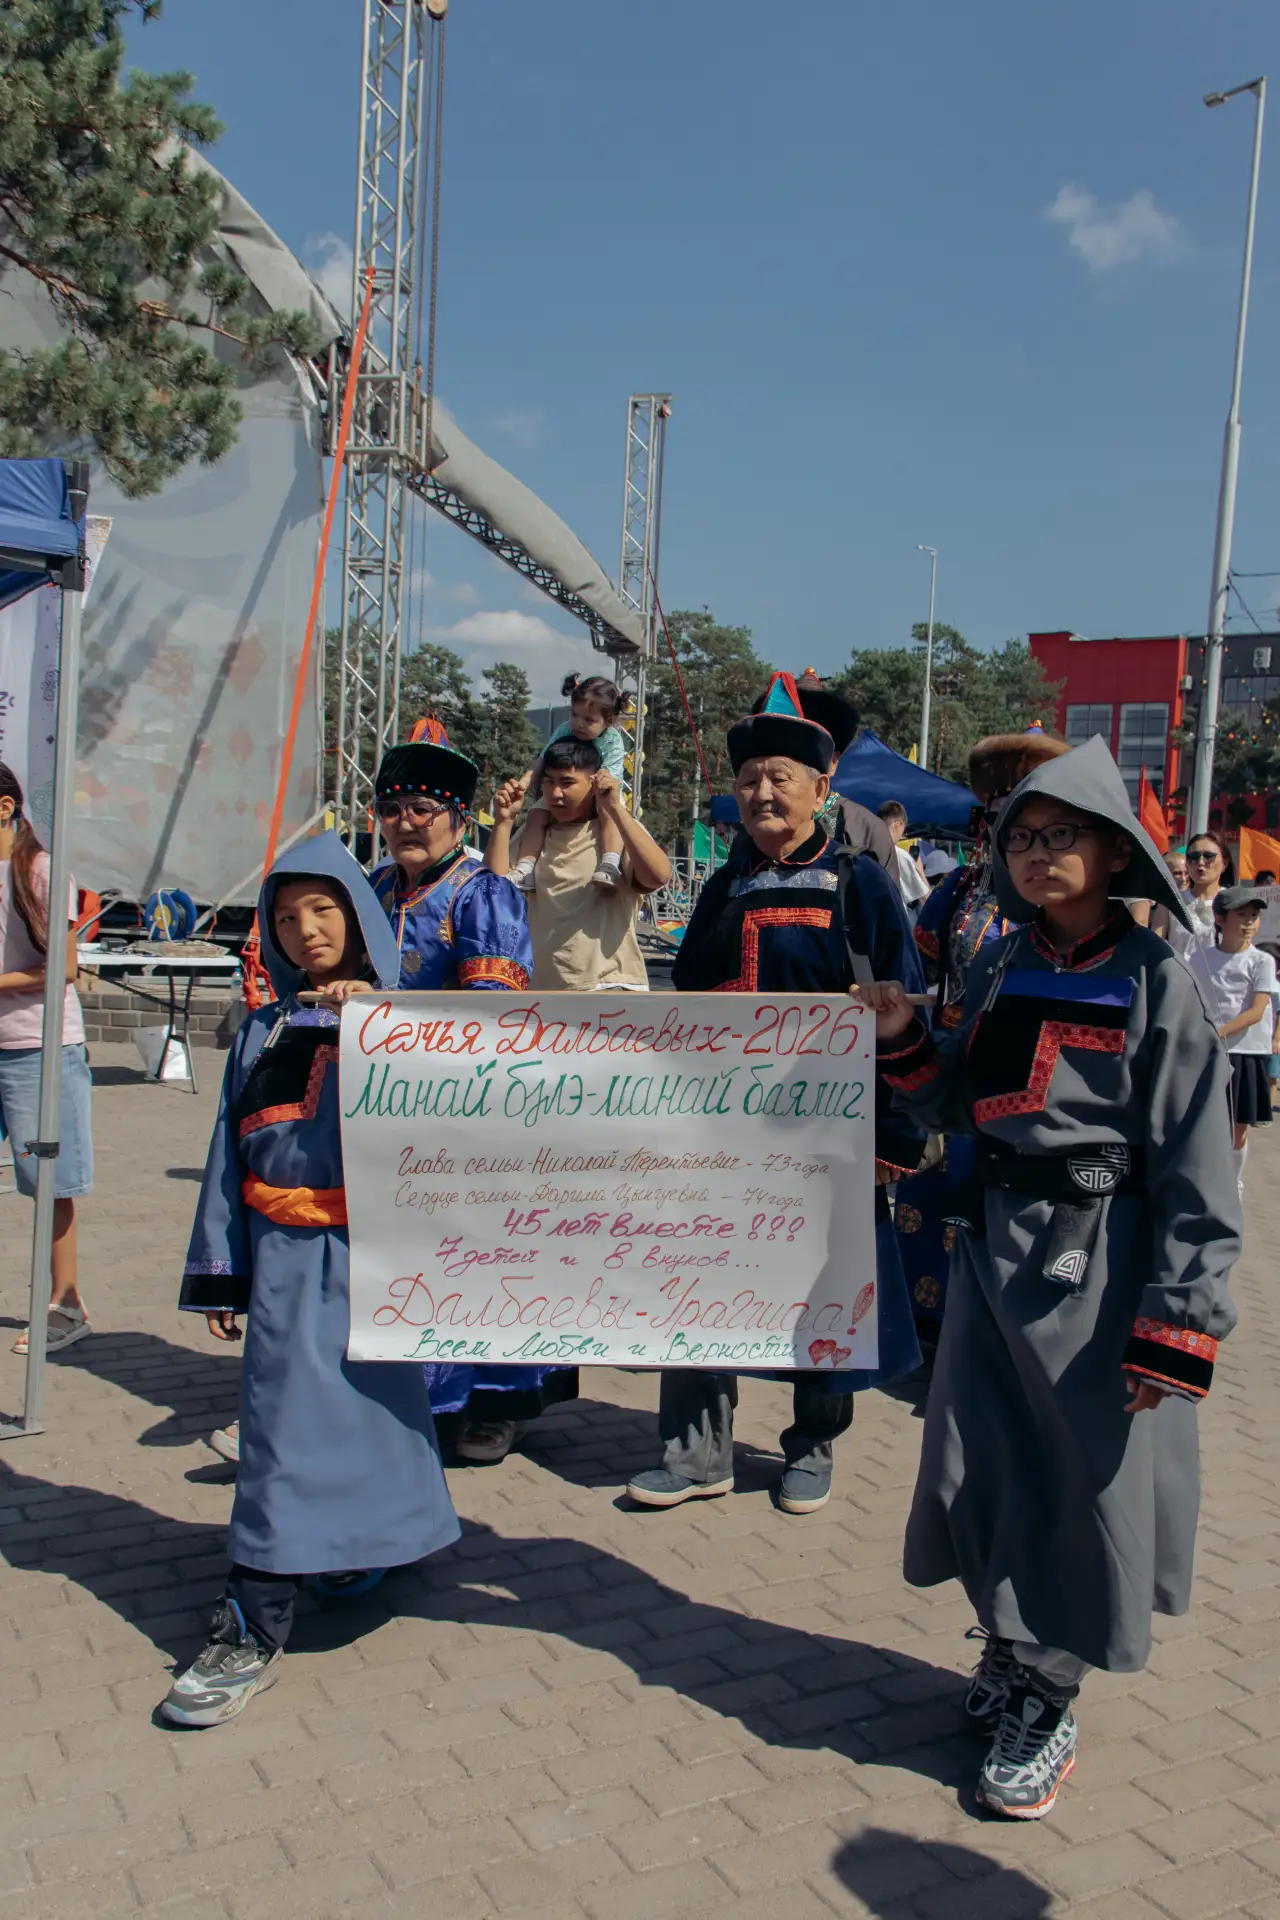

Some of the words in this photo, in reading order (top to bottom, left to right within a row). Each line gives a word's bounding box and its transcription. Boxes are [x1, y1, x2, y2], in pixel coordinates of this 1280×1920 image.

[358, 1000, 486, 1056] Семья
[344, 1059, 498, 1119] Манай
[397, 1145, 456, 1177] Глава
[394, 1180, 460, 1216] Сердце
[609, 1212, 738, 1239] вместе
[559, 1256, 579, 1266] и
[603, 1242, 633, 1270] 8
[403, 1328, 494, 1359] Всем
[502, 1331, 611, 1359] Любви
[627, 1343, 647, 1357] и
[659, 1331, 800, 1363] Верности
